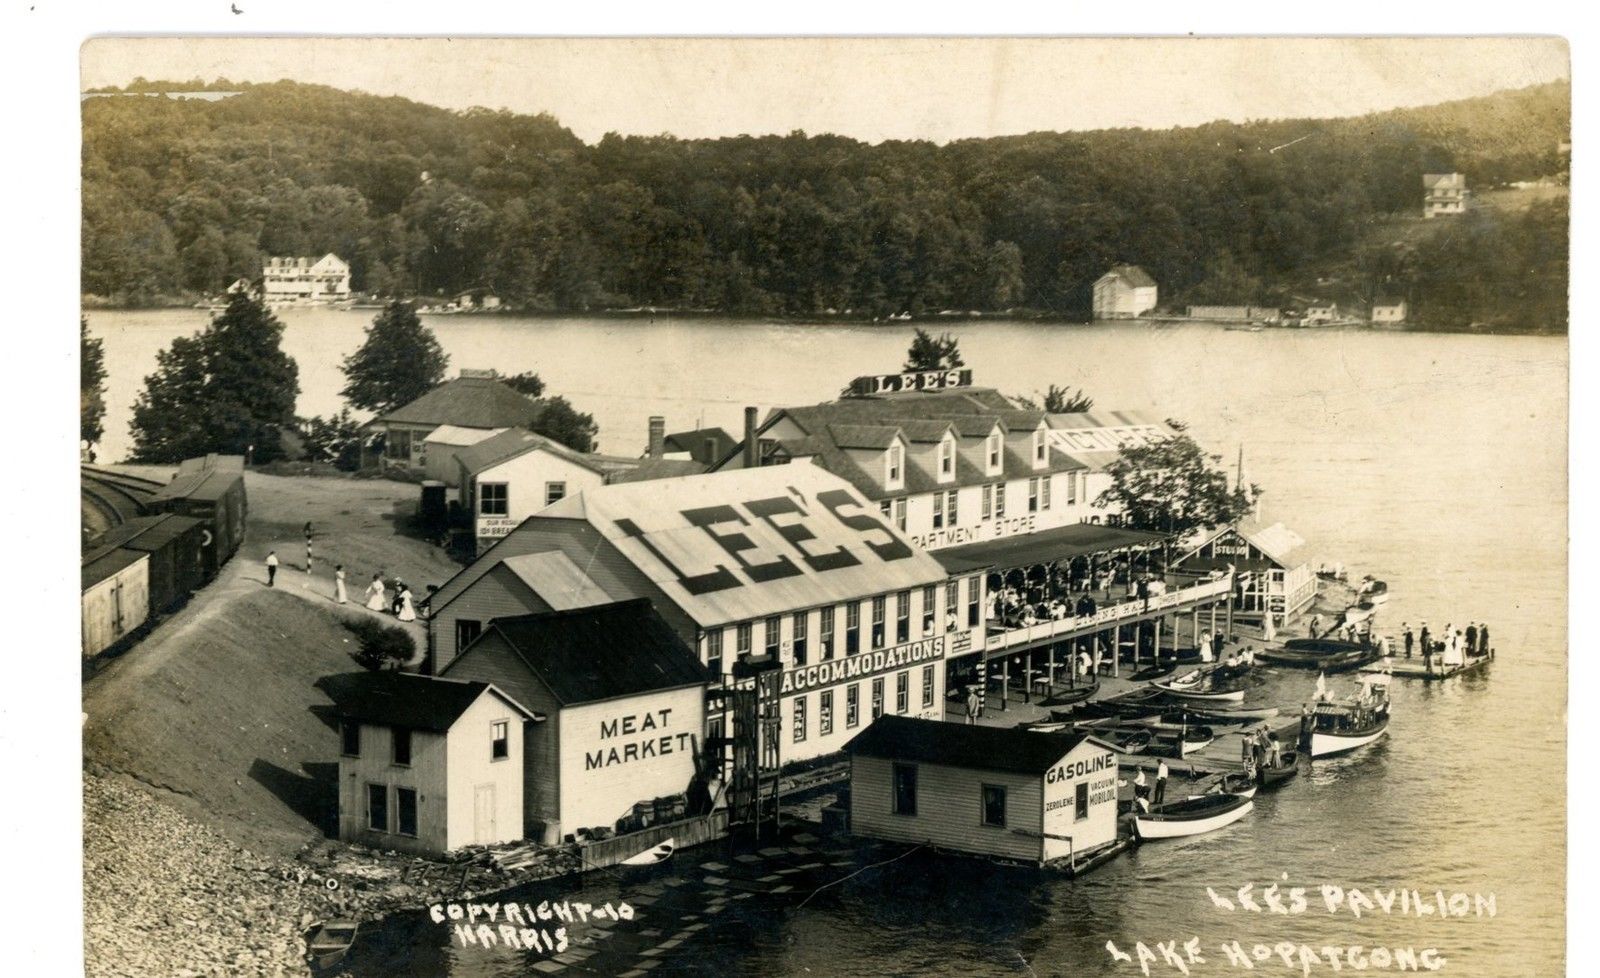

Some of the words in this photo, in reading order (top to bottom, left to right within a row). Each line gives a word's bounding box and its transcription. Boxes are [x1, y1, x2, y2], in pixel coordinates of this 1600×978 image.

[876, 370, 960, 393] LEE'S
[613, 486, 913, 595] LEE'S
[996, 515, 1036, 536] STORE
[781, 637, 944, 693] ACCOMMODATIONS
[600, 708, 672, 740] MEAT
[585, 732, 689, 771] MARKET
[1091, 778, 1115, 791] VACUUM
